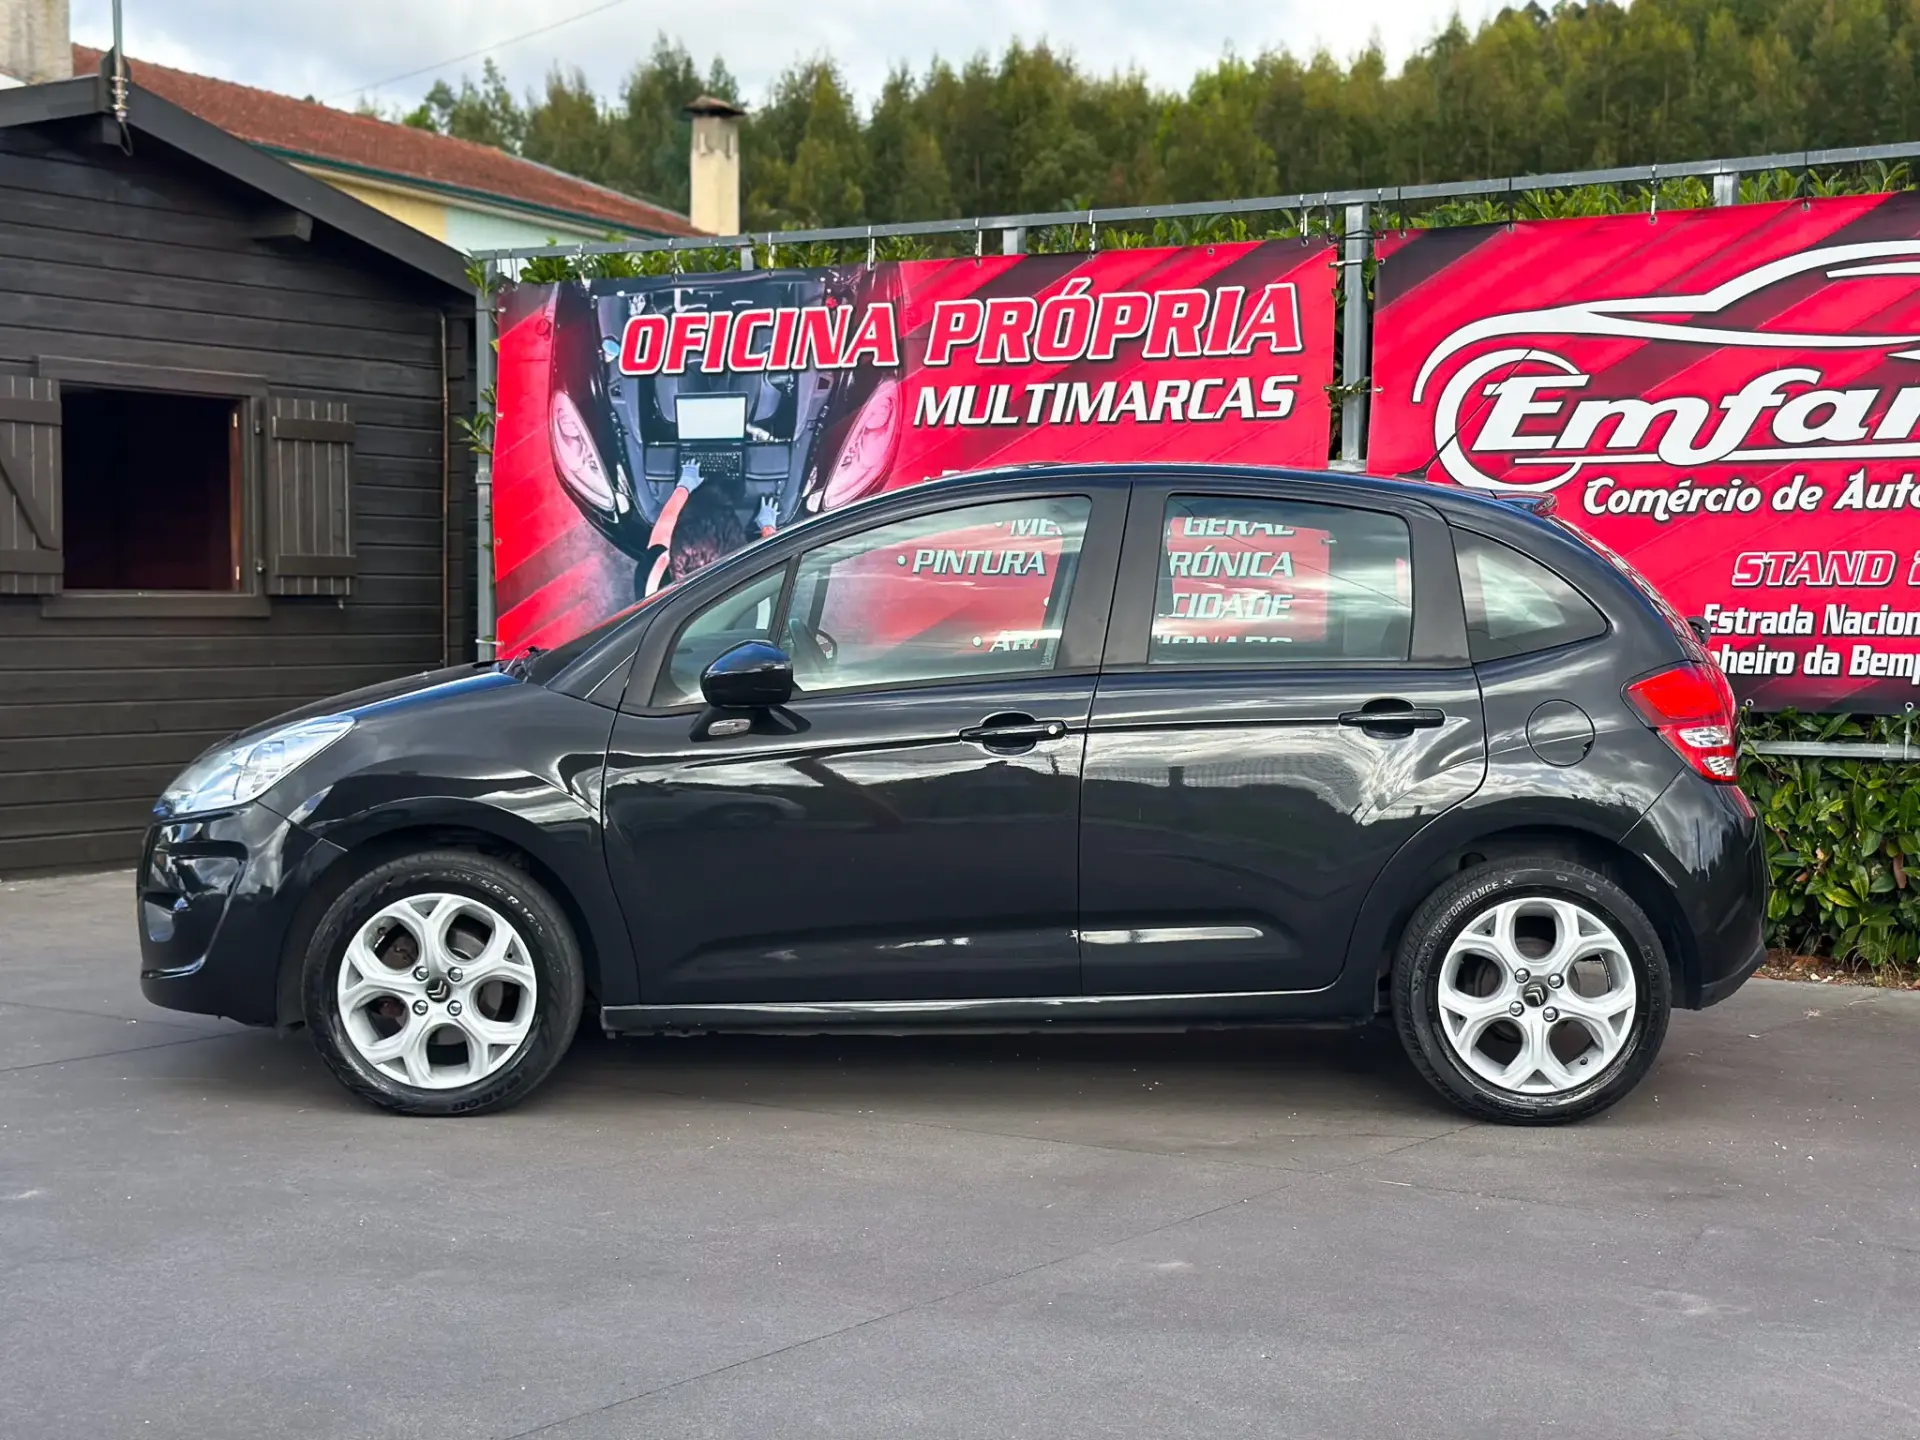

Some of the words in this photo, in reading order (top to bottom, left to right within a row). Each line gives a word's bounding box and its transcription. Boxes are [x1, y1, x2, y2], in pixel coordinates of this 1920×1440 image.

[619, 302, 900, 376] OFICINA
[924, 277, 1302, 366] PRÓPRIA
[913, 375, 1298, 426] MULTIMARCAS
[1583, 476, 1762, 521] Comércio
[1772, 475, 1823, 511] de
[912, 549, 1046, 575] PINTURA
[1168, 544, 1294, 578] RÓNICA
[1731, 550, 1896, 587] STAND
[1158, 592, 1294, 620] CIDADE
[1703, 603, 1814, 635] Estrada
[1822, 603, 1920, 636] Nacion
[1803, 644, 1840, 675] da
